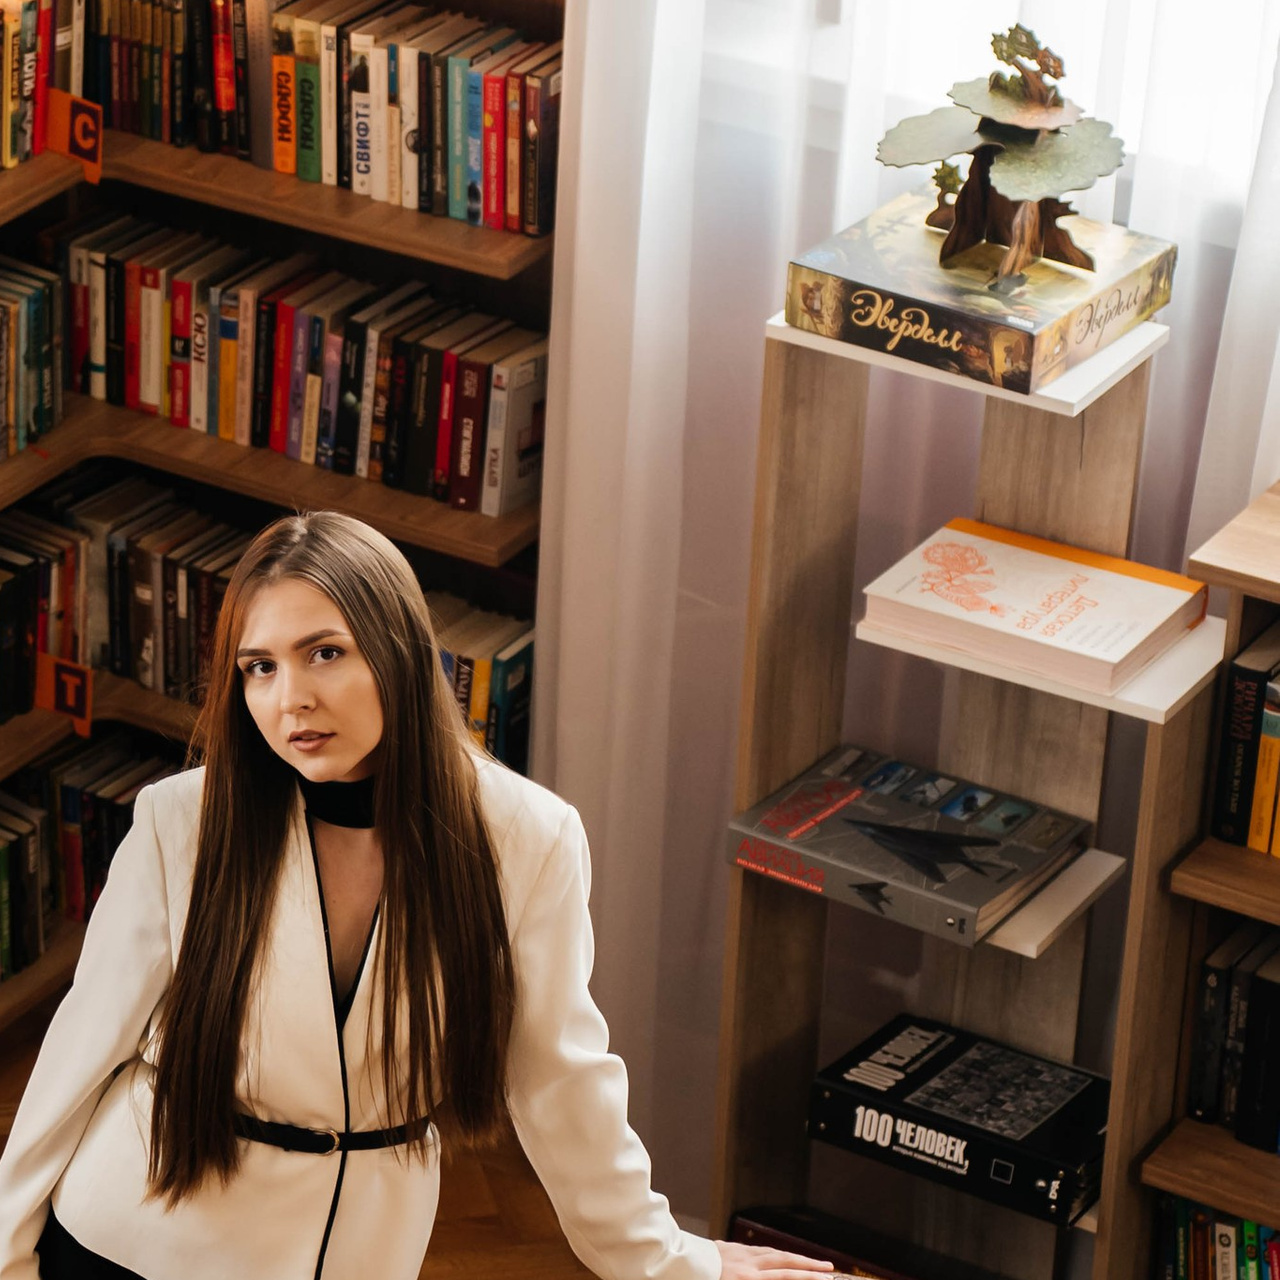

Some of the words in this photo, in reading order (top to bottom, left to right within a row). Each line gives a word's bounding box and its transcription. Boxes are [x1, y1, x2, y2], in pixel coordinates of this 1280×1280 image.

[74, 114, 97, 150] С
[276, 70, 291, 143] САФОН
[299, 78, 315, 151] САФОН
[355, 110, 371, 174] СВИФТ
[850, 290, 963, 352] Эверделл
[487, 447, 500, 487] ШУТКА
[1020, 572, 1090, 631] литература
[1041, 594, 1100, 637] Детская
[61, 676, 80, 708] Т
[853, 1105, 894, 1148] 100
[895, 1118, 970, 1170] ЧЕЛОВЕК,
